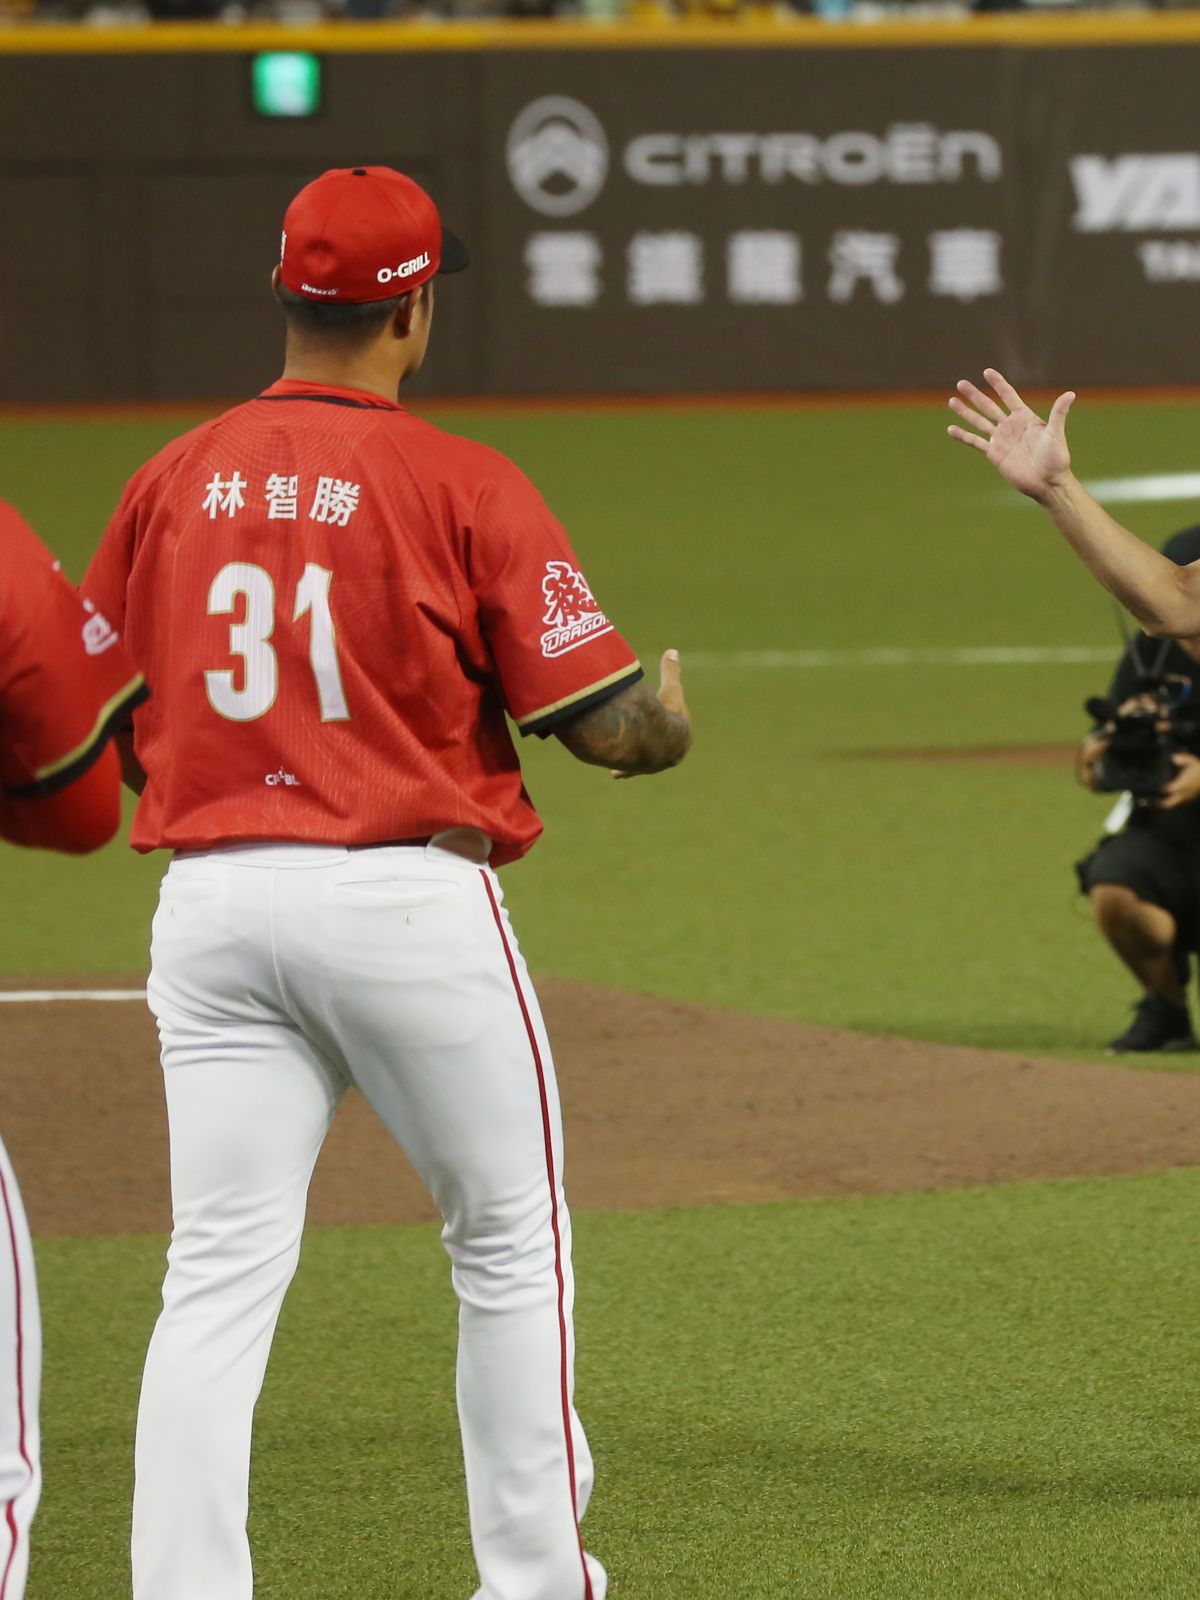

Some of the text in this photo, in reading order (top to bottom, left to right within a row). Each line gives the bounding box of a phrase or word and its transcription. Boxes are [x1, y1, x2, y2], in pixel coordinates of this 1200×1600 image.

[376, 251, 431, 283] O-GRILL
[201, 471, 361, 527] 林智勝
[203, 561, 351, 723] 31
